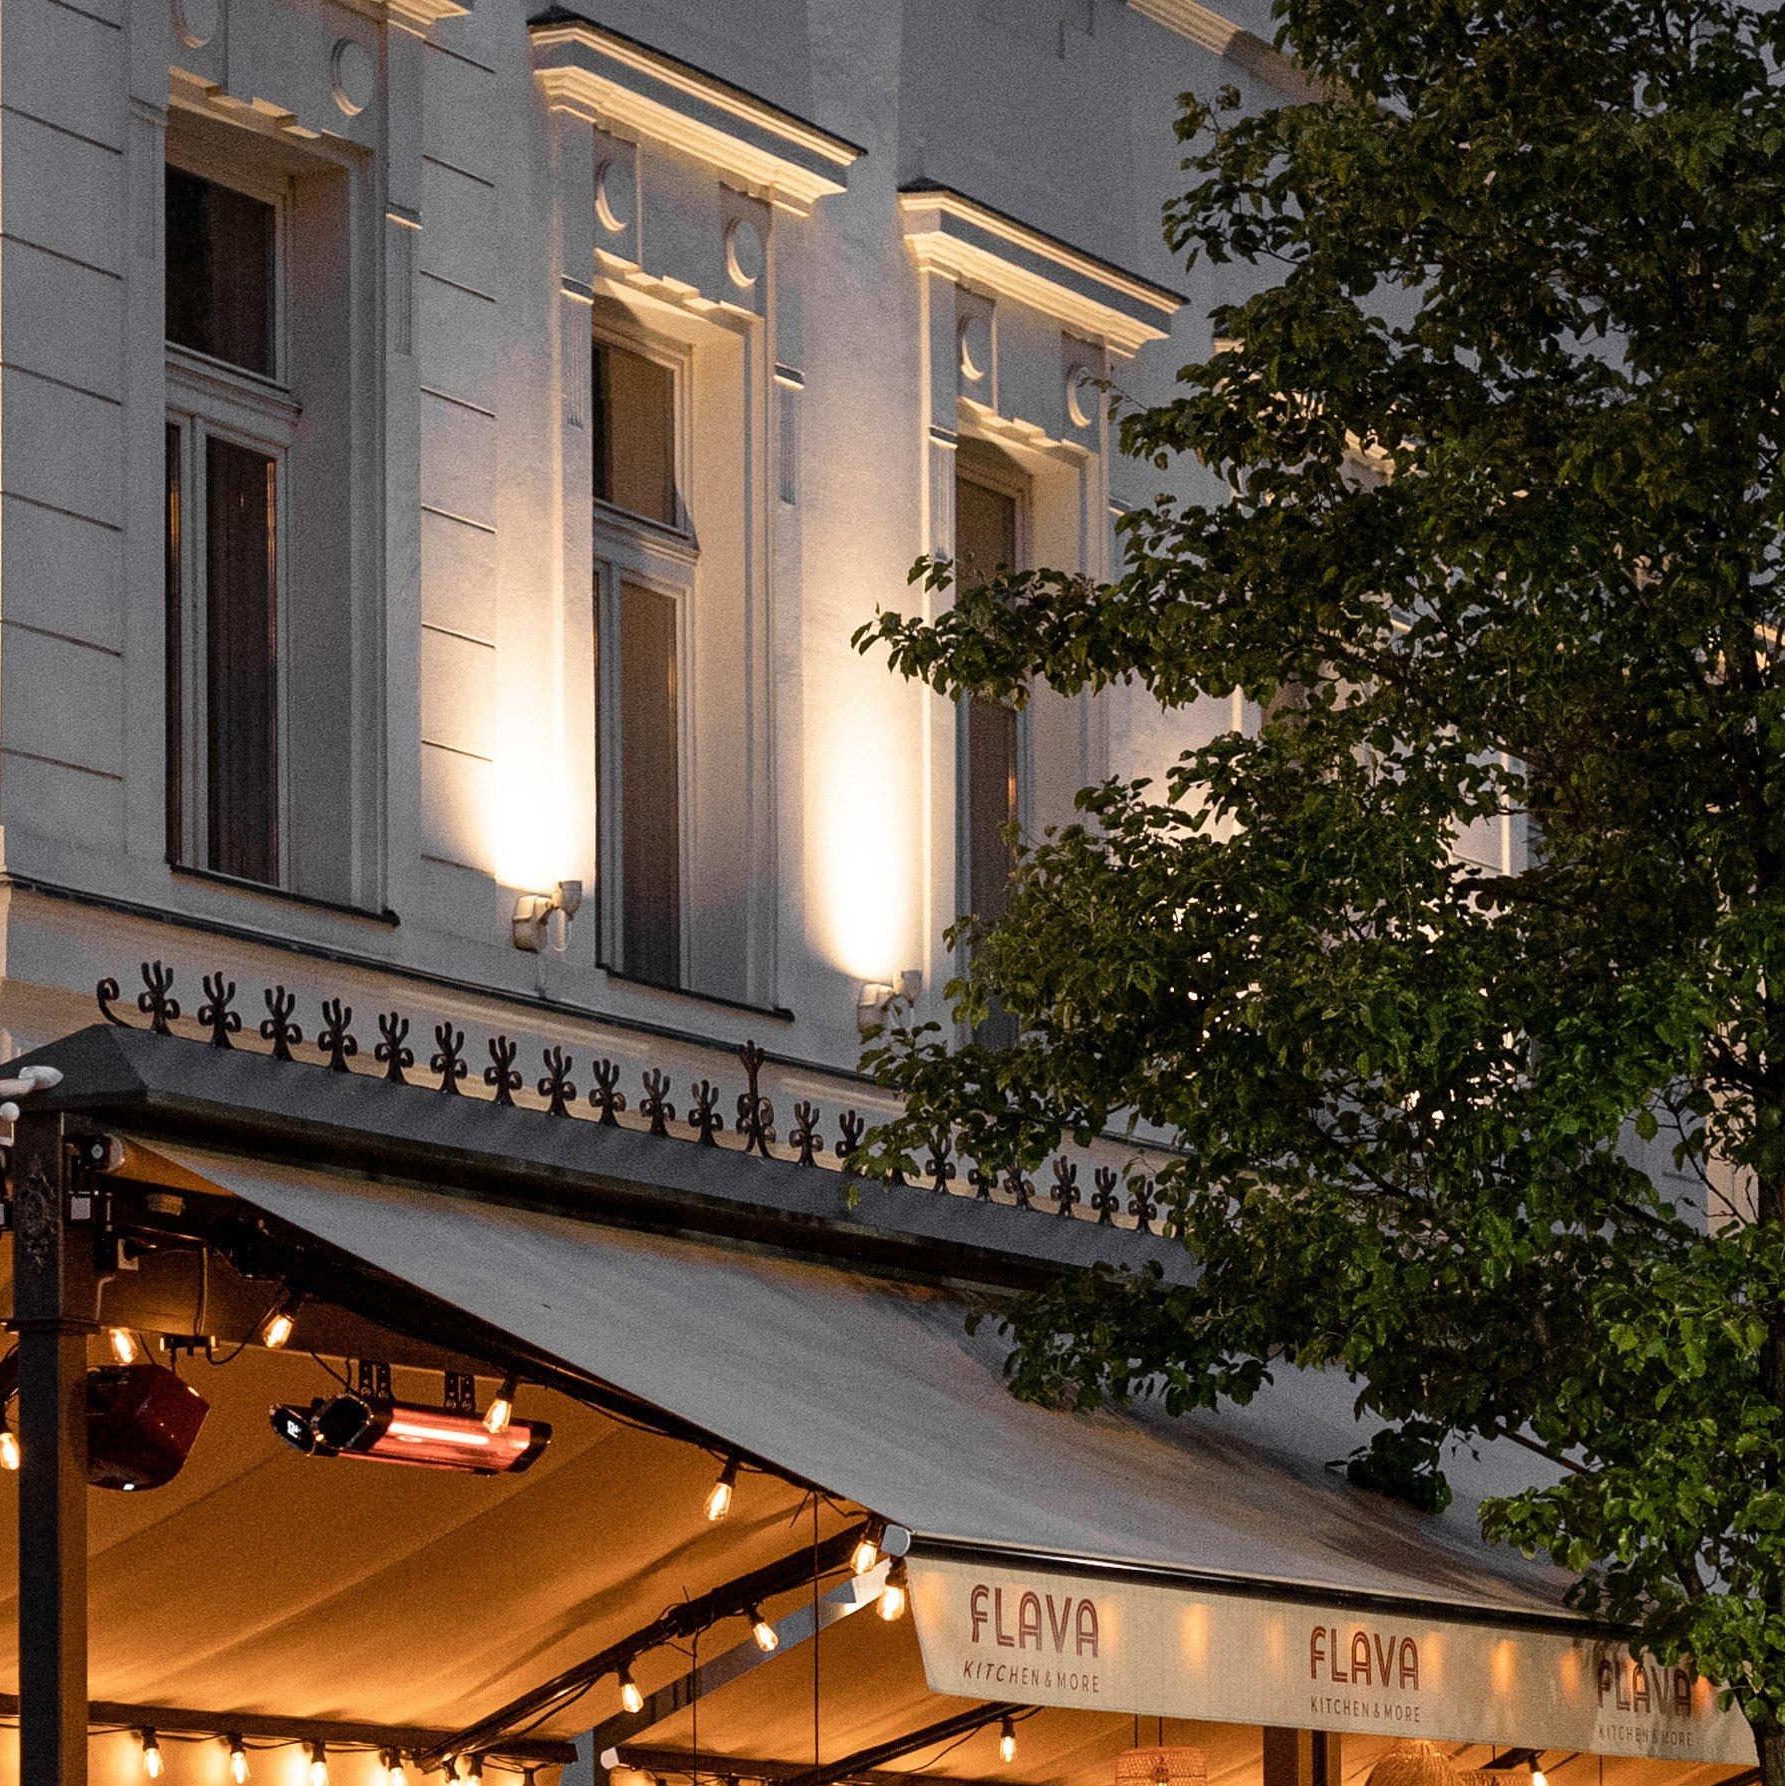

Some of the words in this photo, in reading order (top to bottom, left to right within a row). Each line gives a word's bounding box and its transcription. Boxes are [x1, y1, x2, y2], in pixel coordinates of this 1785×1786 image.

[970, 1583, 1099, 1658] FLAVA
[964, 1660, 1039, 1687] KITCHEN
[1057, 1672, 1100, 1693] MORE
[1310, 1625, 1419, 1691] FLAVA
[1311, 1696, 1369, 1718] KITCHEN
[1384, 1703, 1421, 1723] MORE
[1597, 1659, 1692, 1718] FLAVA
